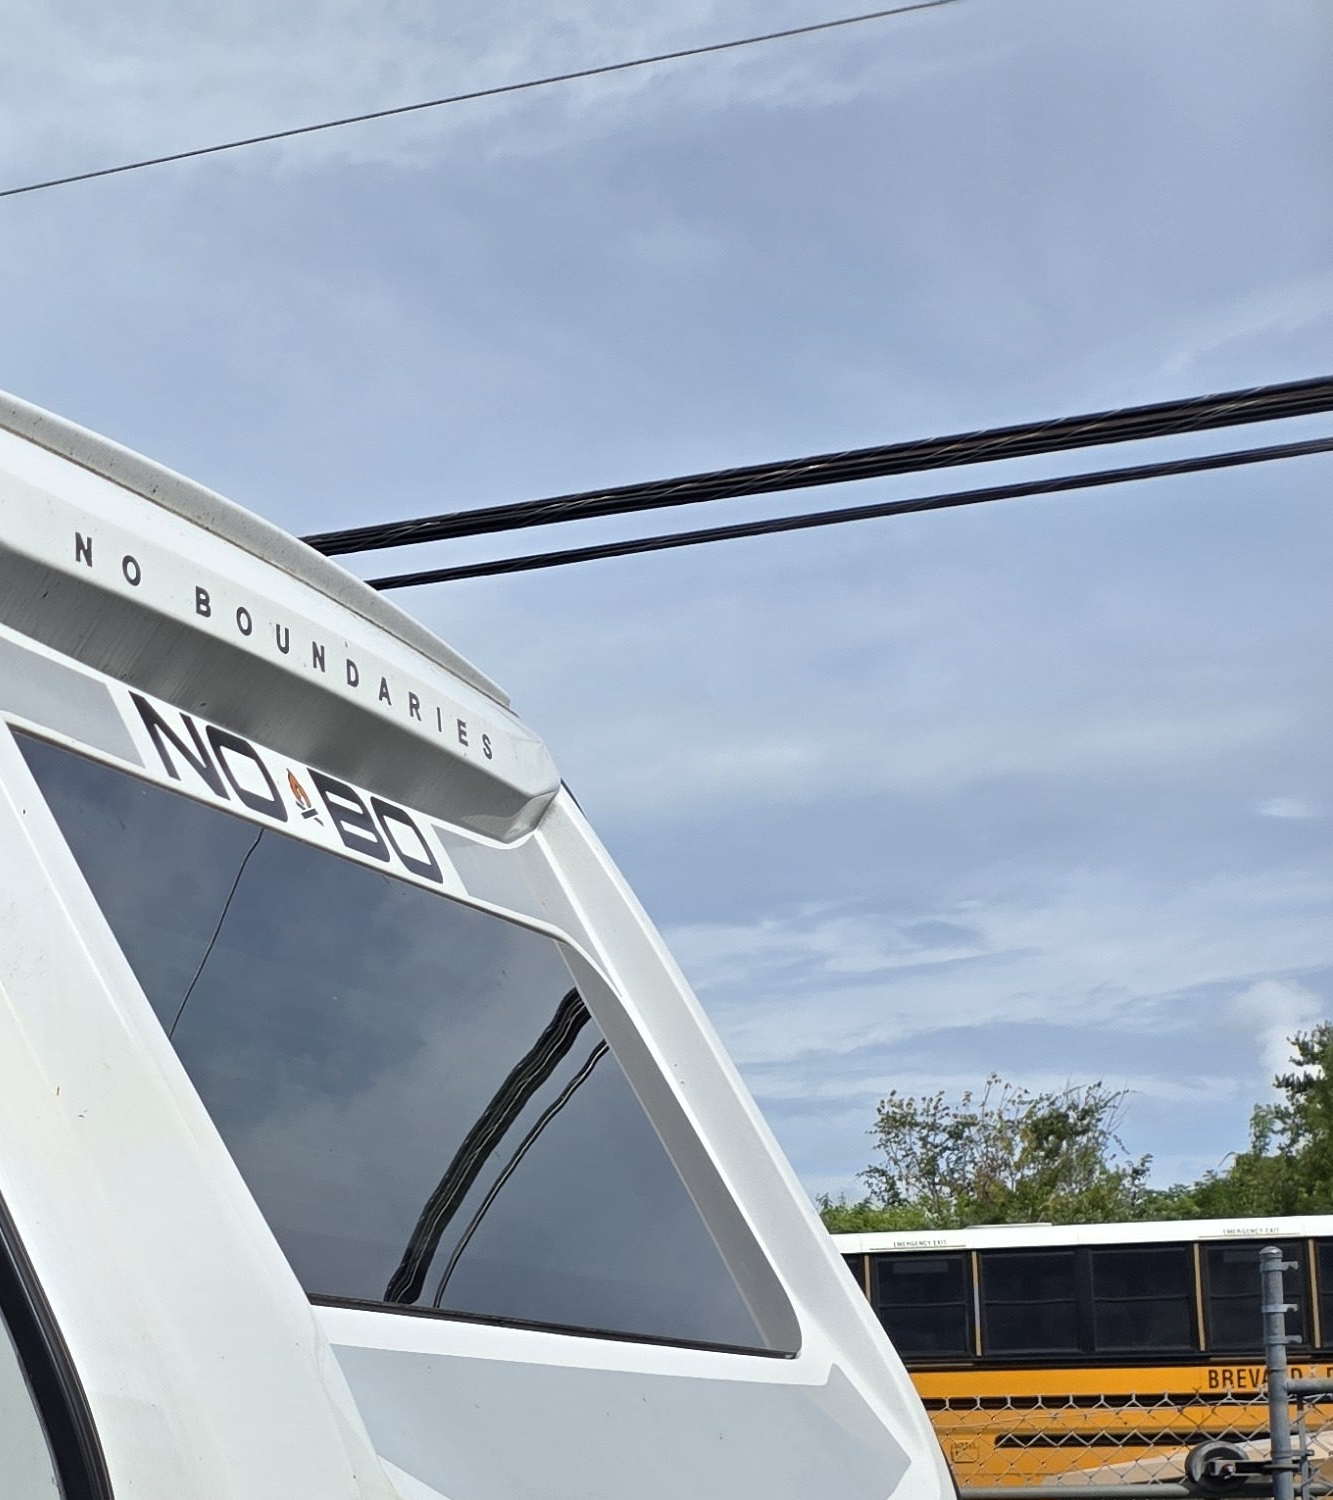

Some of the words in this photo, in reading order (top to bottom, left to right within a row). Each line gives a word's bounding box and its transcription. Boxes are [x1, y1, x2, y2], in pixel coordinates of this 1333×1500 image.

[74, 531, 142, 587] NO
[194, 585, 494, 761] BOUNDARIES
[1207, 1366, 1303, 1390] BREVD
